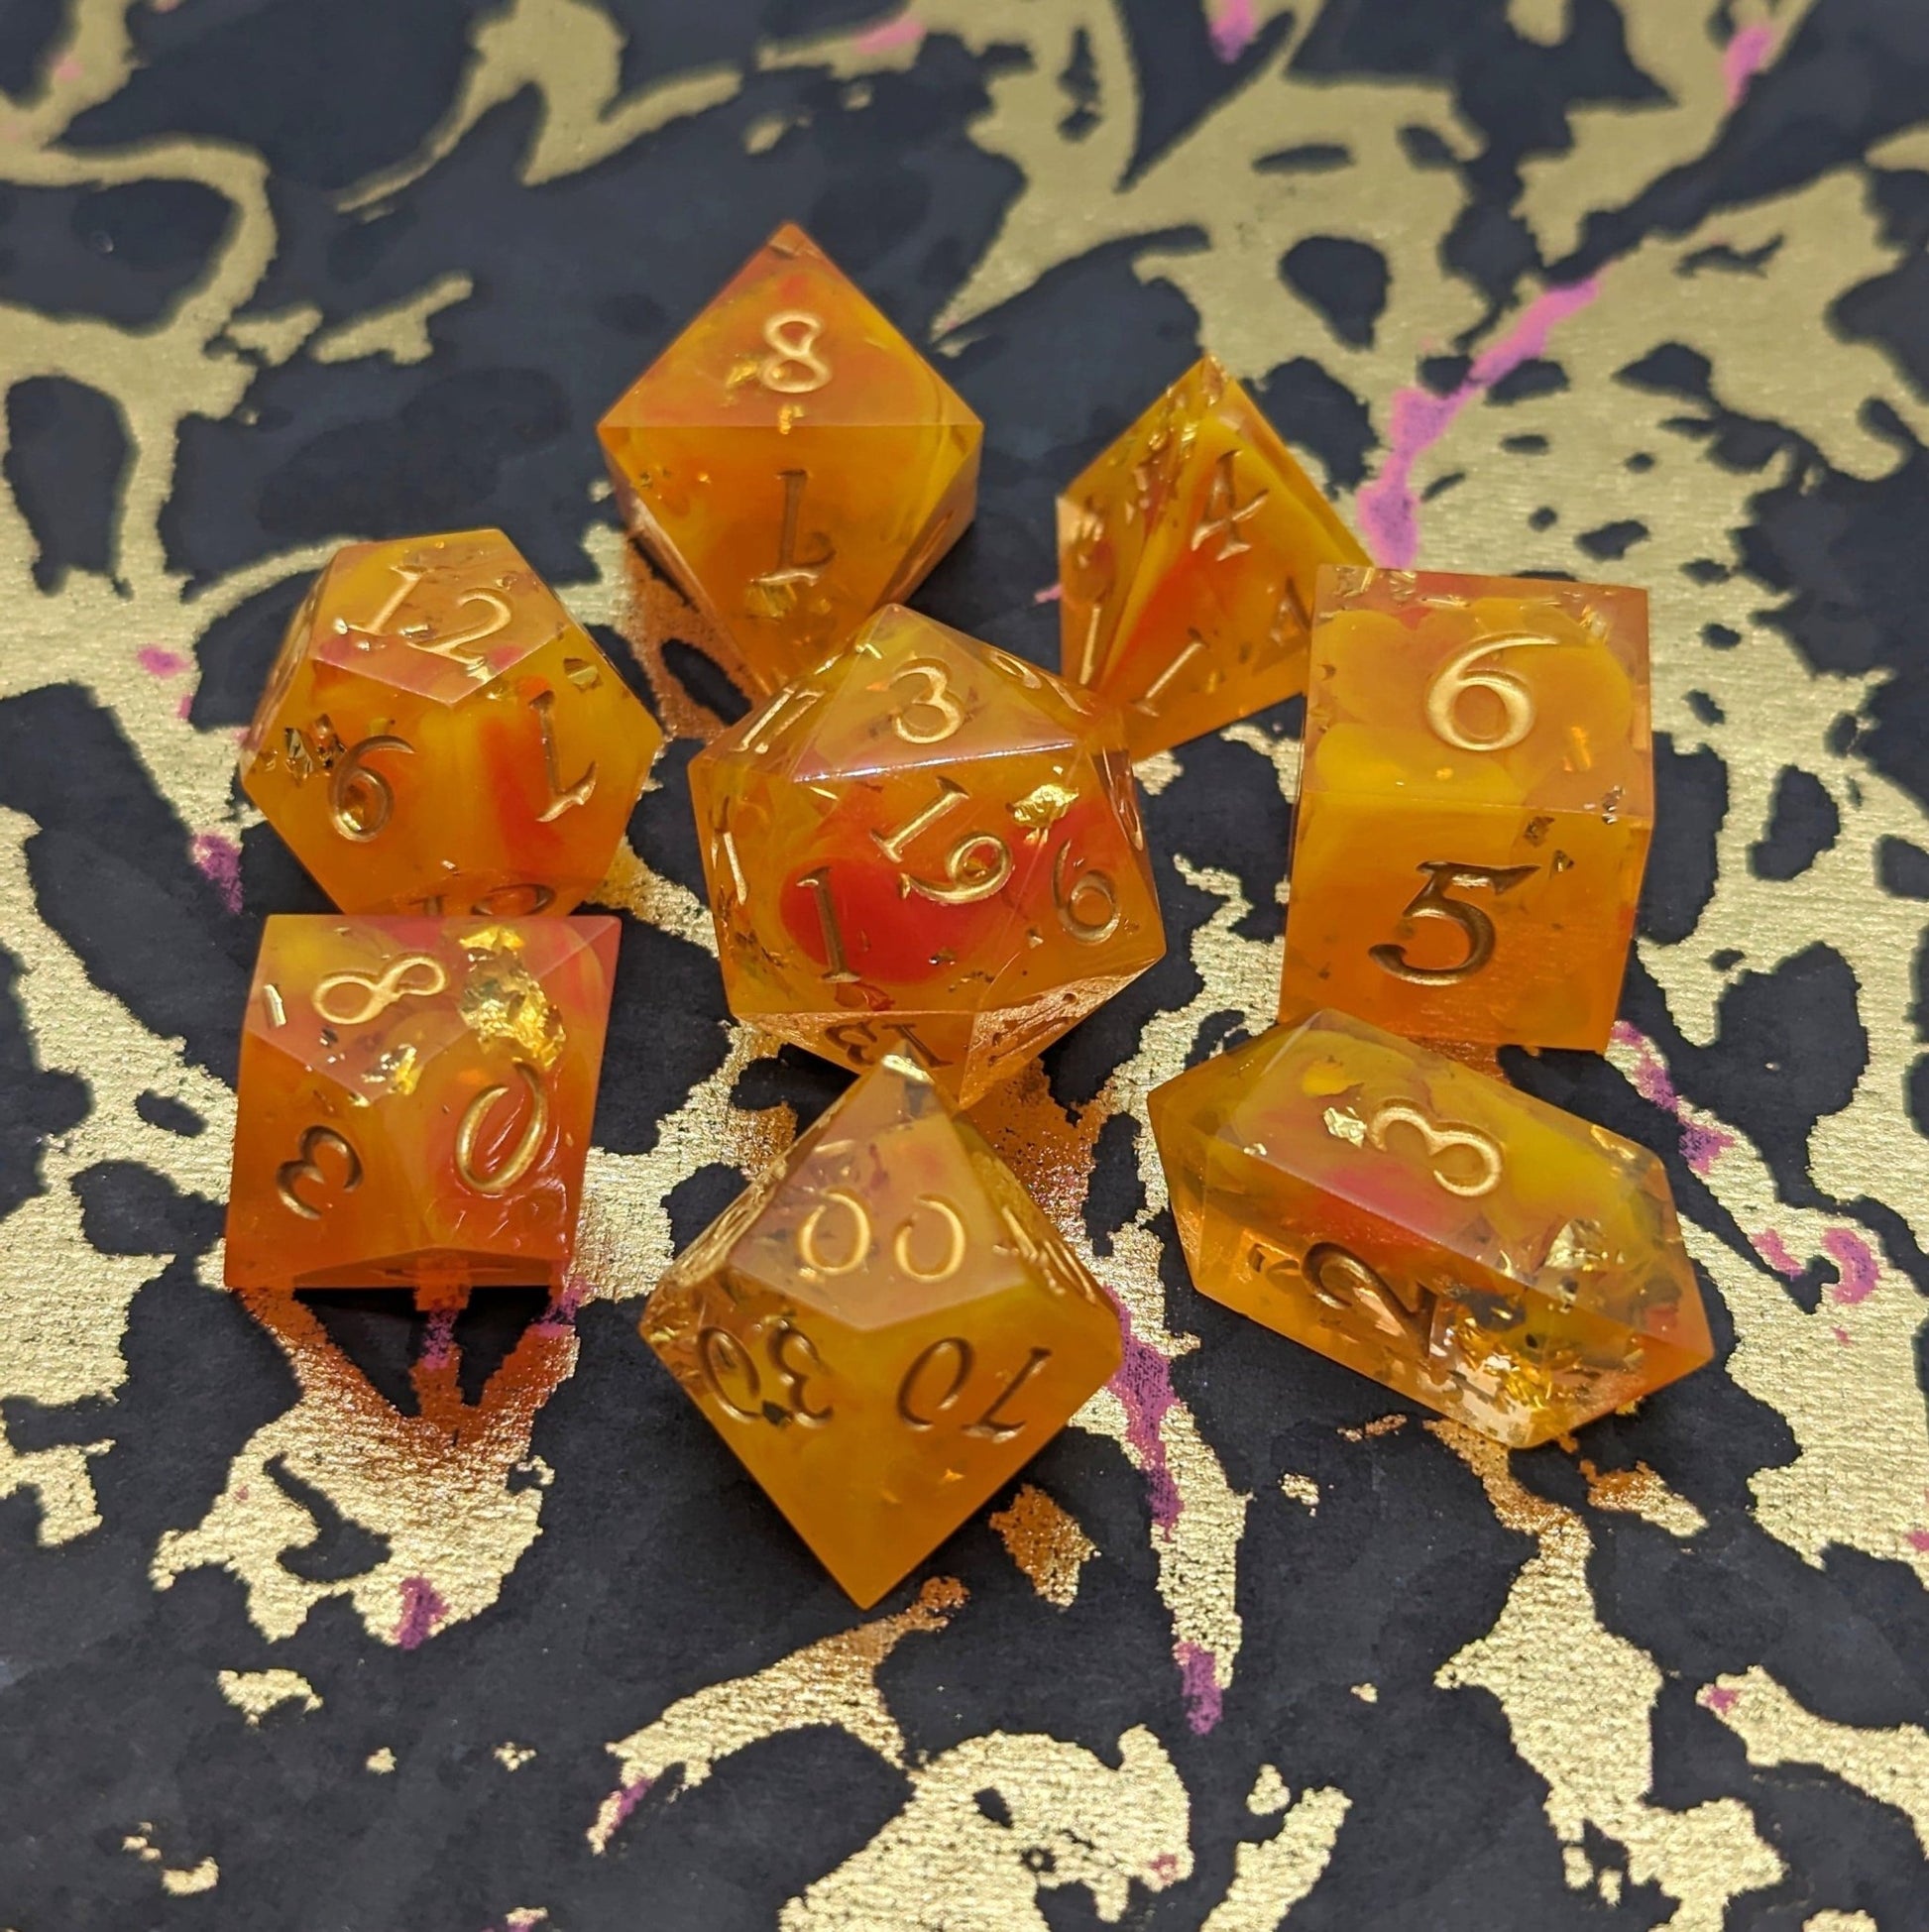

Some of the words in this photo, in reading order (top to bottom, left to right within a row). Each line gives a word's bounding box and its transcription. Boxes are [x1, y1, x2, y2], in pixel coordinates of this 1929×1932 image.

[760, 311, 833, 395] 8
[347, 562, 511, 670] 12
[889, 658, 965, 745] 3
[1423, 629, 1560, 753] 6
[327, 734, 417, 845] 6
[869, 776, 1016, 905] 19
[796, 865, 862, 984] 1
[1367, 859, 1542, 987] 5
[311, 951, 448, 1026] 8
[455, 1060, 550, 1193] 0
[1363, 1096, 1506, 1198] 3
[799, 1190, 967, 1286] 00
[1301, 1241, 1437, 1360] 2
